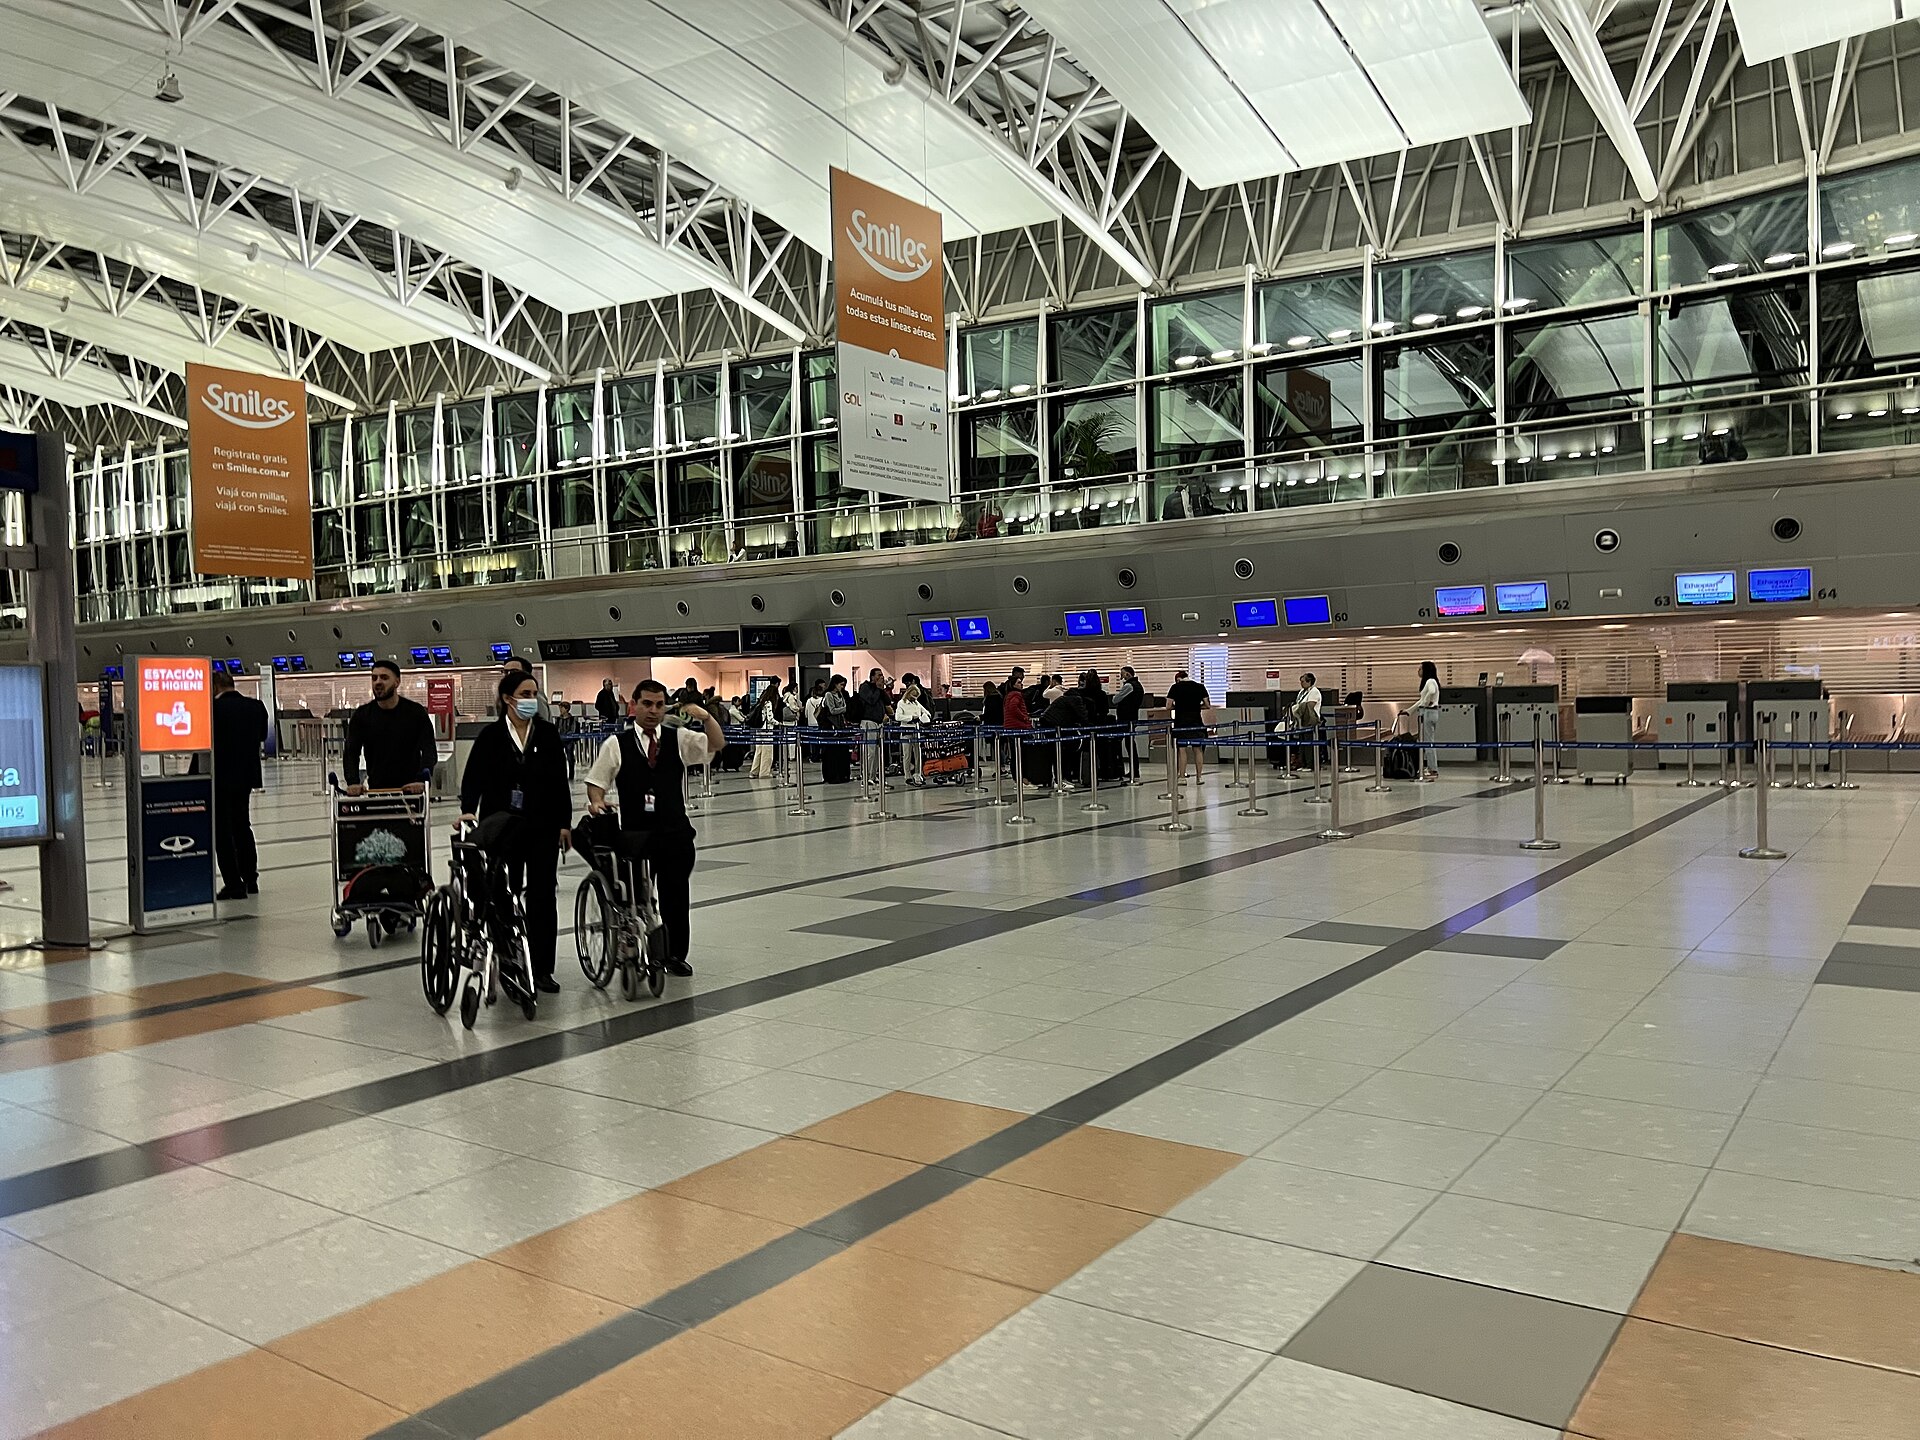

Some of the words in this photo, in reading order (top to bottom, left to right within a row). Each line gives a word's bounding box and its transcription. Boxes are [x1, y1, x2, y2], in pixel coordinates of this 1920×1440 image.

[849, 209, 929, 271] Smiles
[850, 288, 883, 306] Acumulá
[885, 300, 896, 311] tus
[898, 305, 918, 319] millas
[920, 312, 932, 322] con
[846, 305, 868, 320] todas
[870, 314, 889, 327] estas
[206, 383, 290, 420] Smiles
[844, 392, 861, 406] GOL
[263, 455, 287, 464] gratis
[226, 463, 290, 478] Smiles.com.ar
[216, 486, 239, 498] Viajá
[241, 491, 257, 499] con
[260, 491, 288, 504] millas,
[215, 501, 236, 512] viajá
[257, 504, 289, 515] Smiles.
[1818, 589, 1837, 600] 64
[1554, 601, 1570, 610] 62
[1654, 596, 1670, 607] 63
[1334, 613, 1348, 622] 60
[1418, 608, 1430, 618] 61
[1151, 623, 1162, 631] 58
[1219, 619, 1231, 628] 59
[994, 631, 1004, 639] 56
[1054, 628, 1064, 636] 57
[911, 635, 920, 643] 55
[144, 667, 203, 680] ESTACIÓN
[144, 681, 159, 691] DE
[162, 681, 203, 691] HIGIENE
